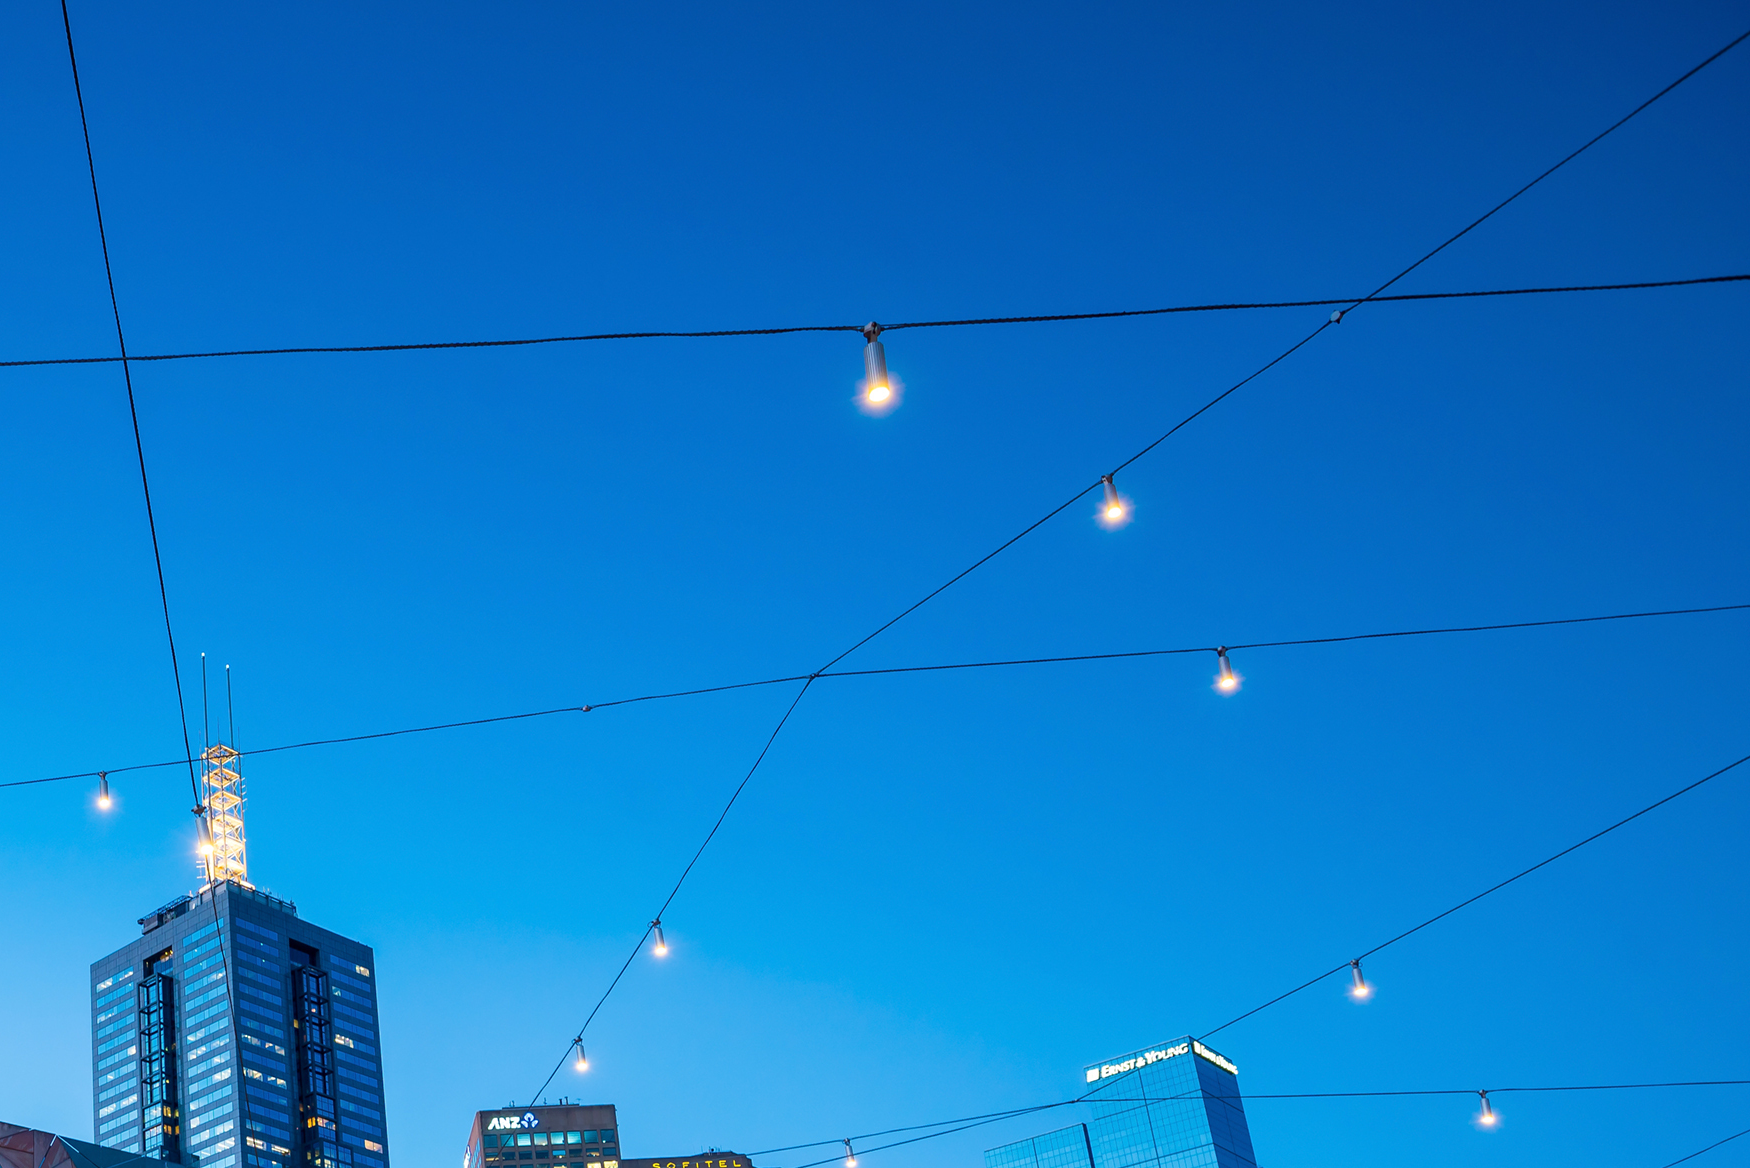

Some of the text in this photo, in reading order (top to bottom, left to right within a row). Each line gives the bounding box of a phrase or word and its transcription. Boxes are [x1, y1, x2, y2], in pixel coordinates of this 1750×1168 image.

[1101, 1058, 1136, 1078] ERNST
[1144, 1043, 1188, 1066] YOUNG
[487, 1115, 522, 1131] ANZ
